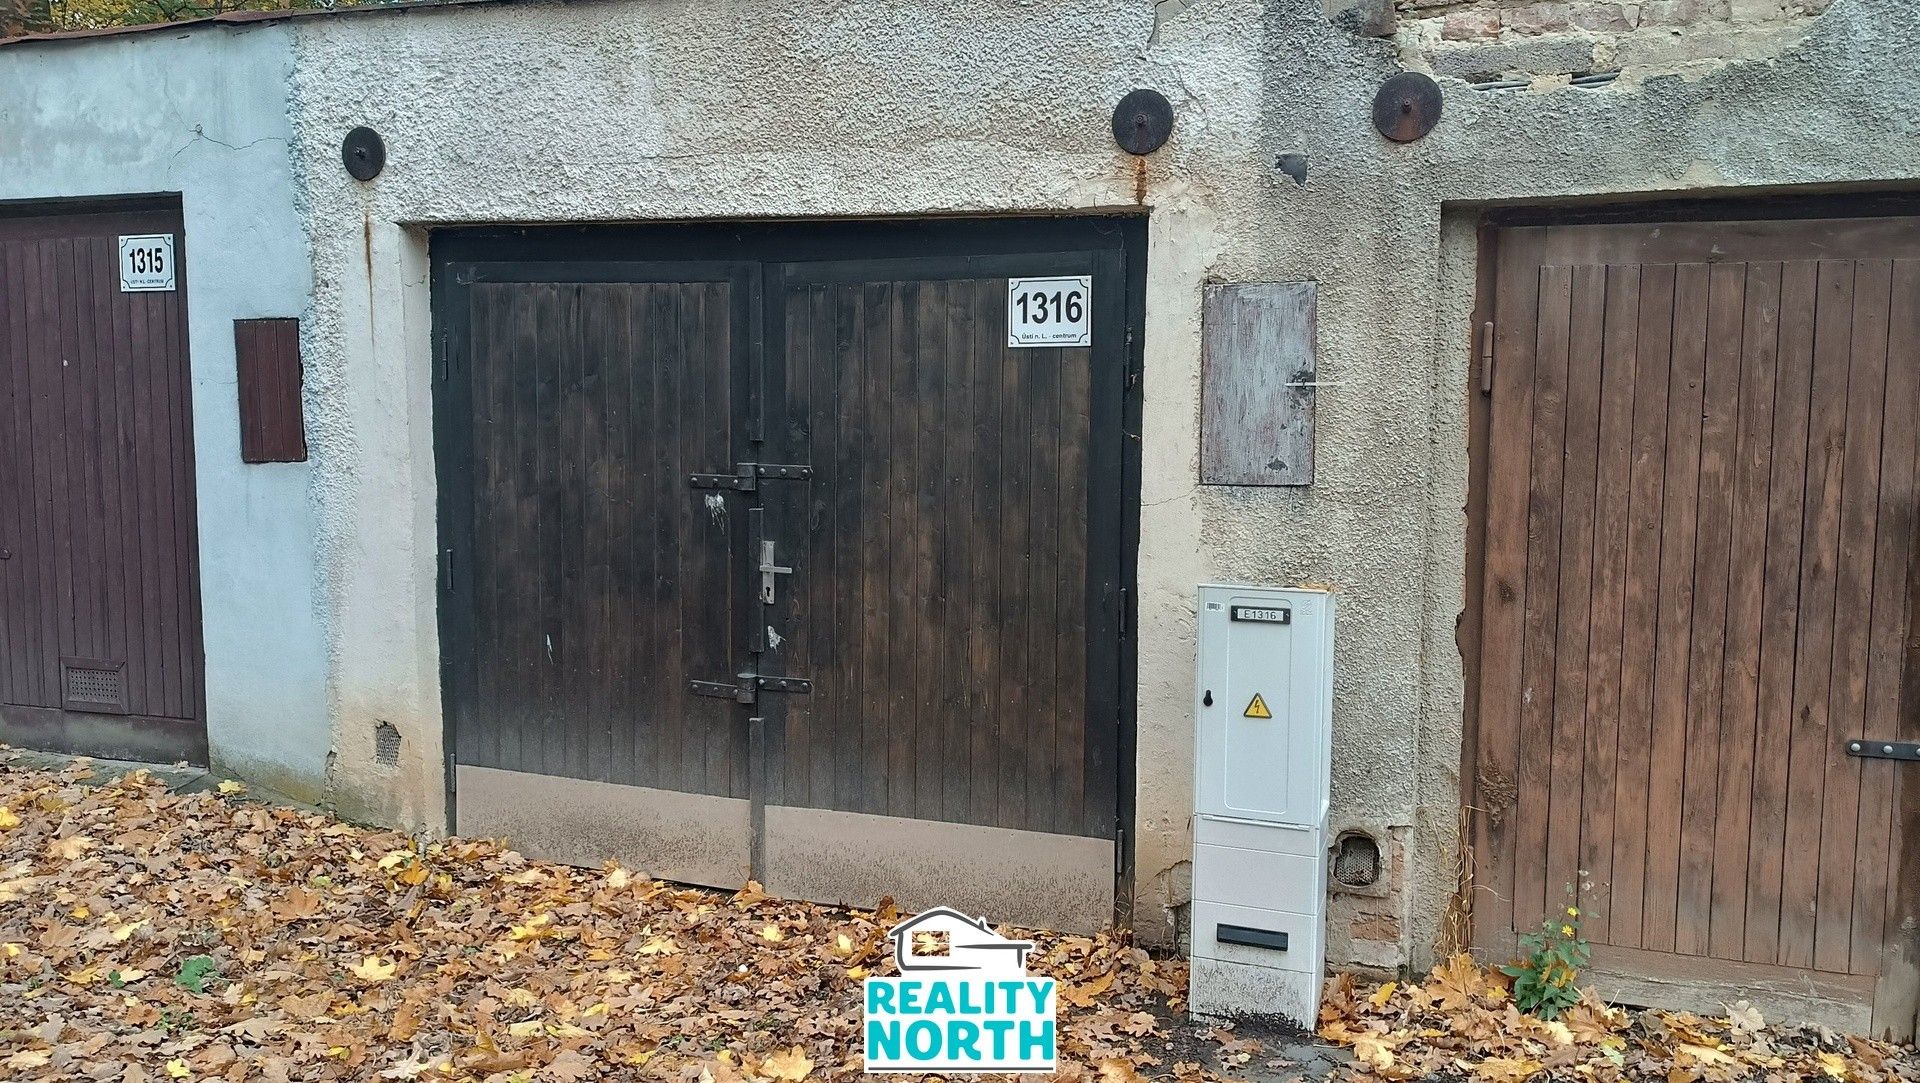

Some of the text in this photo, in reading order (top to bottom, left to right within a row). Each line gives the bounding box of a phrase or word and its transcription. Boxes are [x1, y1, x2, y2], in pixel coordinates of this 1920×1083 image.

[129, 248, 163, 274] 1315
[1016, 290, 1083, 325] 1316
[1244, 609, 1277, 620] E1316
